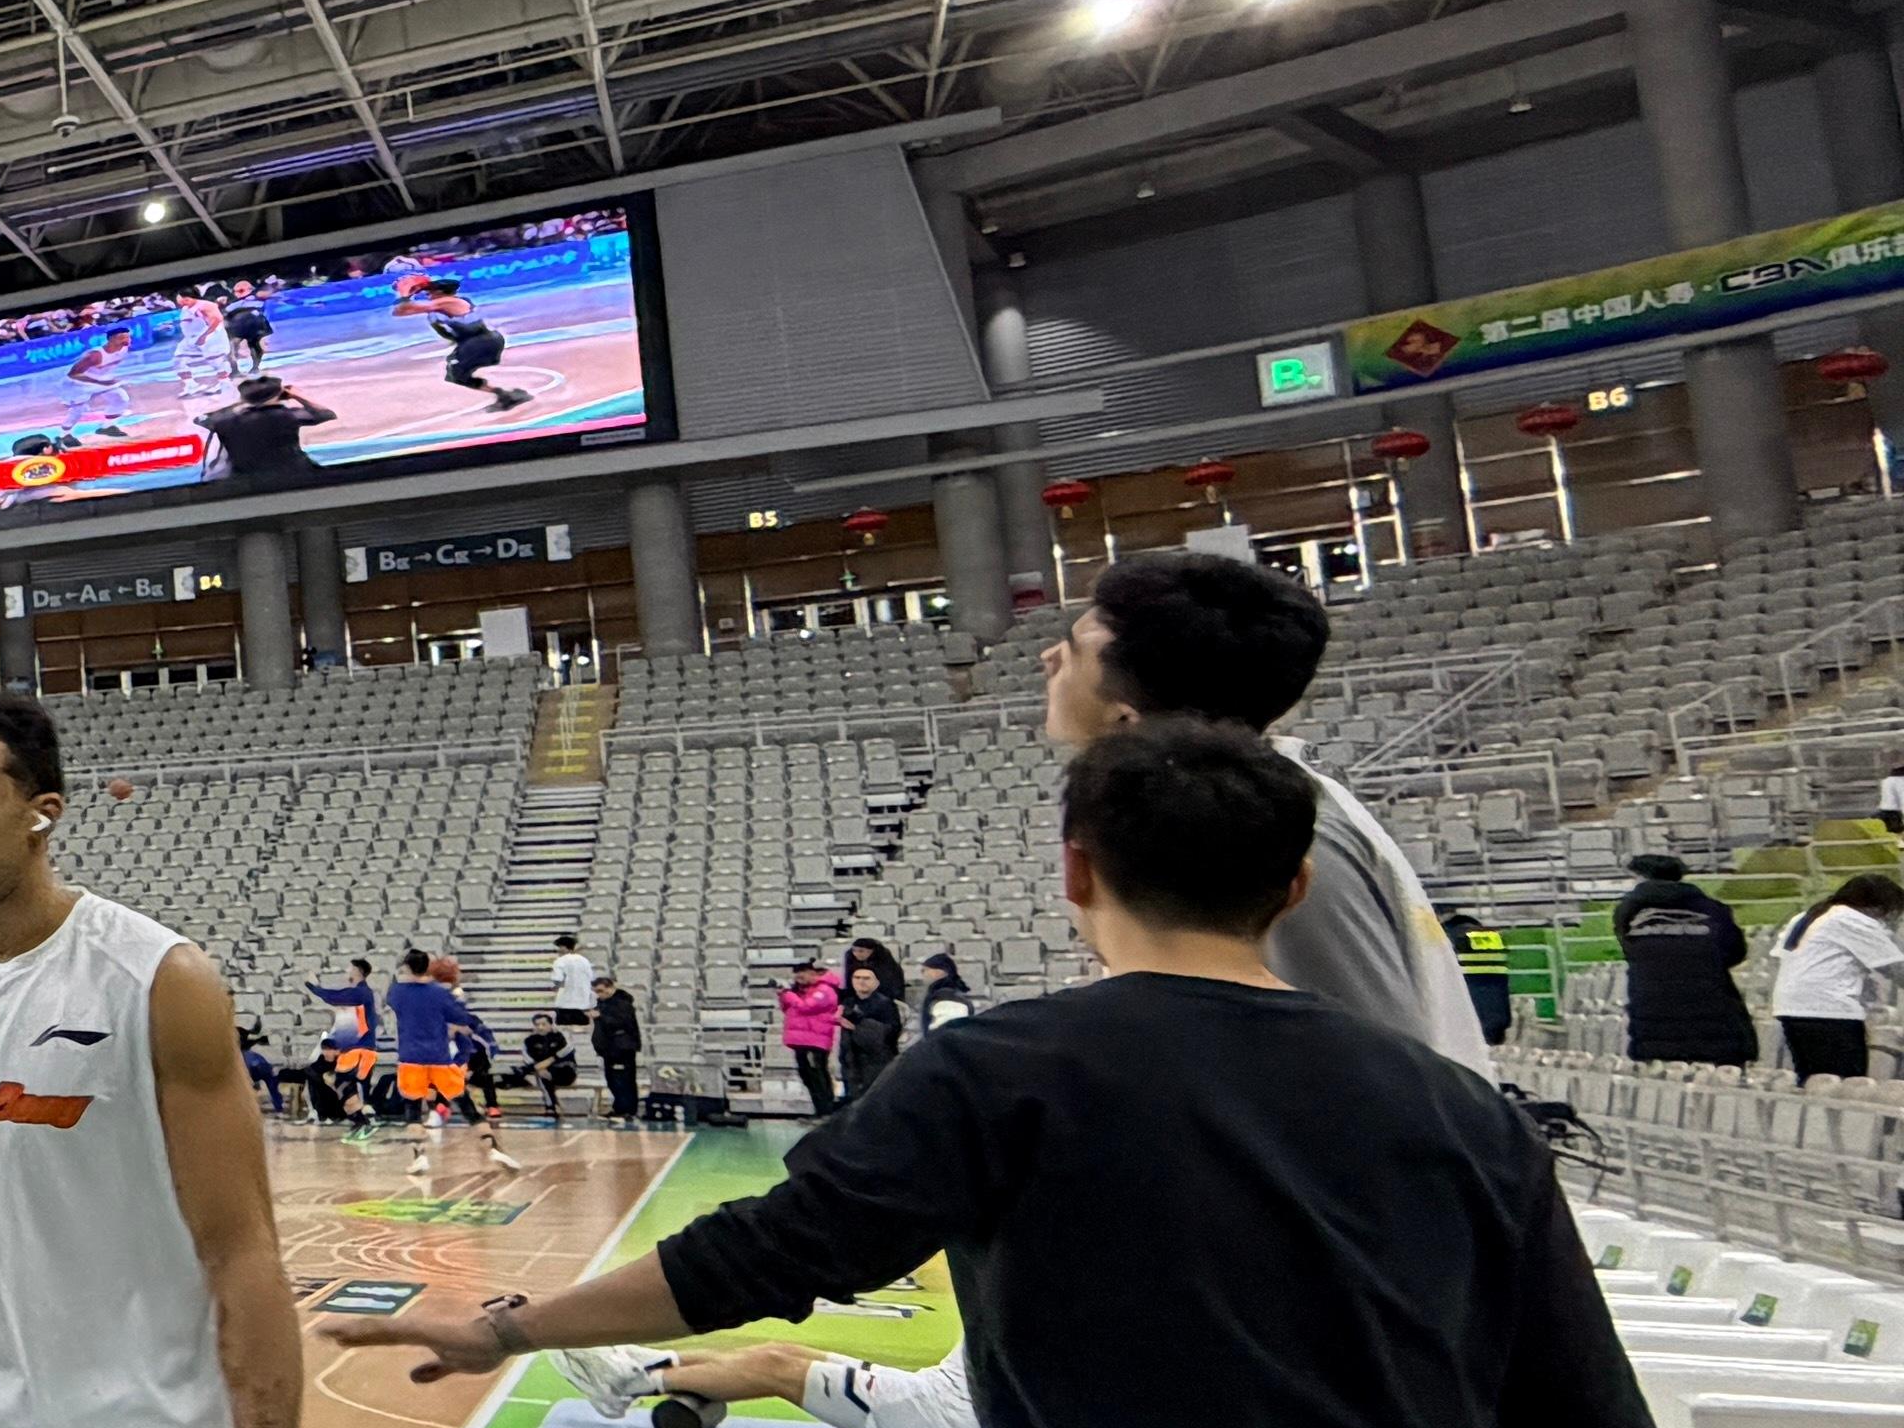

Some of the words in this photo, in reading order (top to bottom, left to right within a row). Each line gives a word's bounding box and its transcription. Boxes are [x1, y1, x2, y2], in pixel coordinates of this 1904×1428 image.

[1588, 387, 1629, 412] B6
[749, 510, 778, 529] B5
[199, 575, 223, 590] B4
